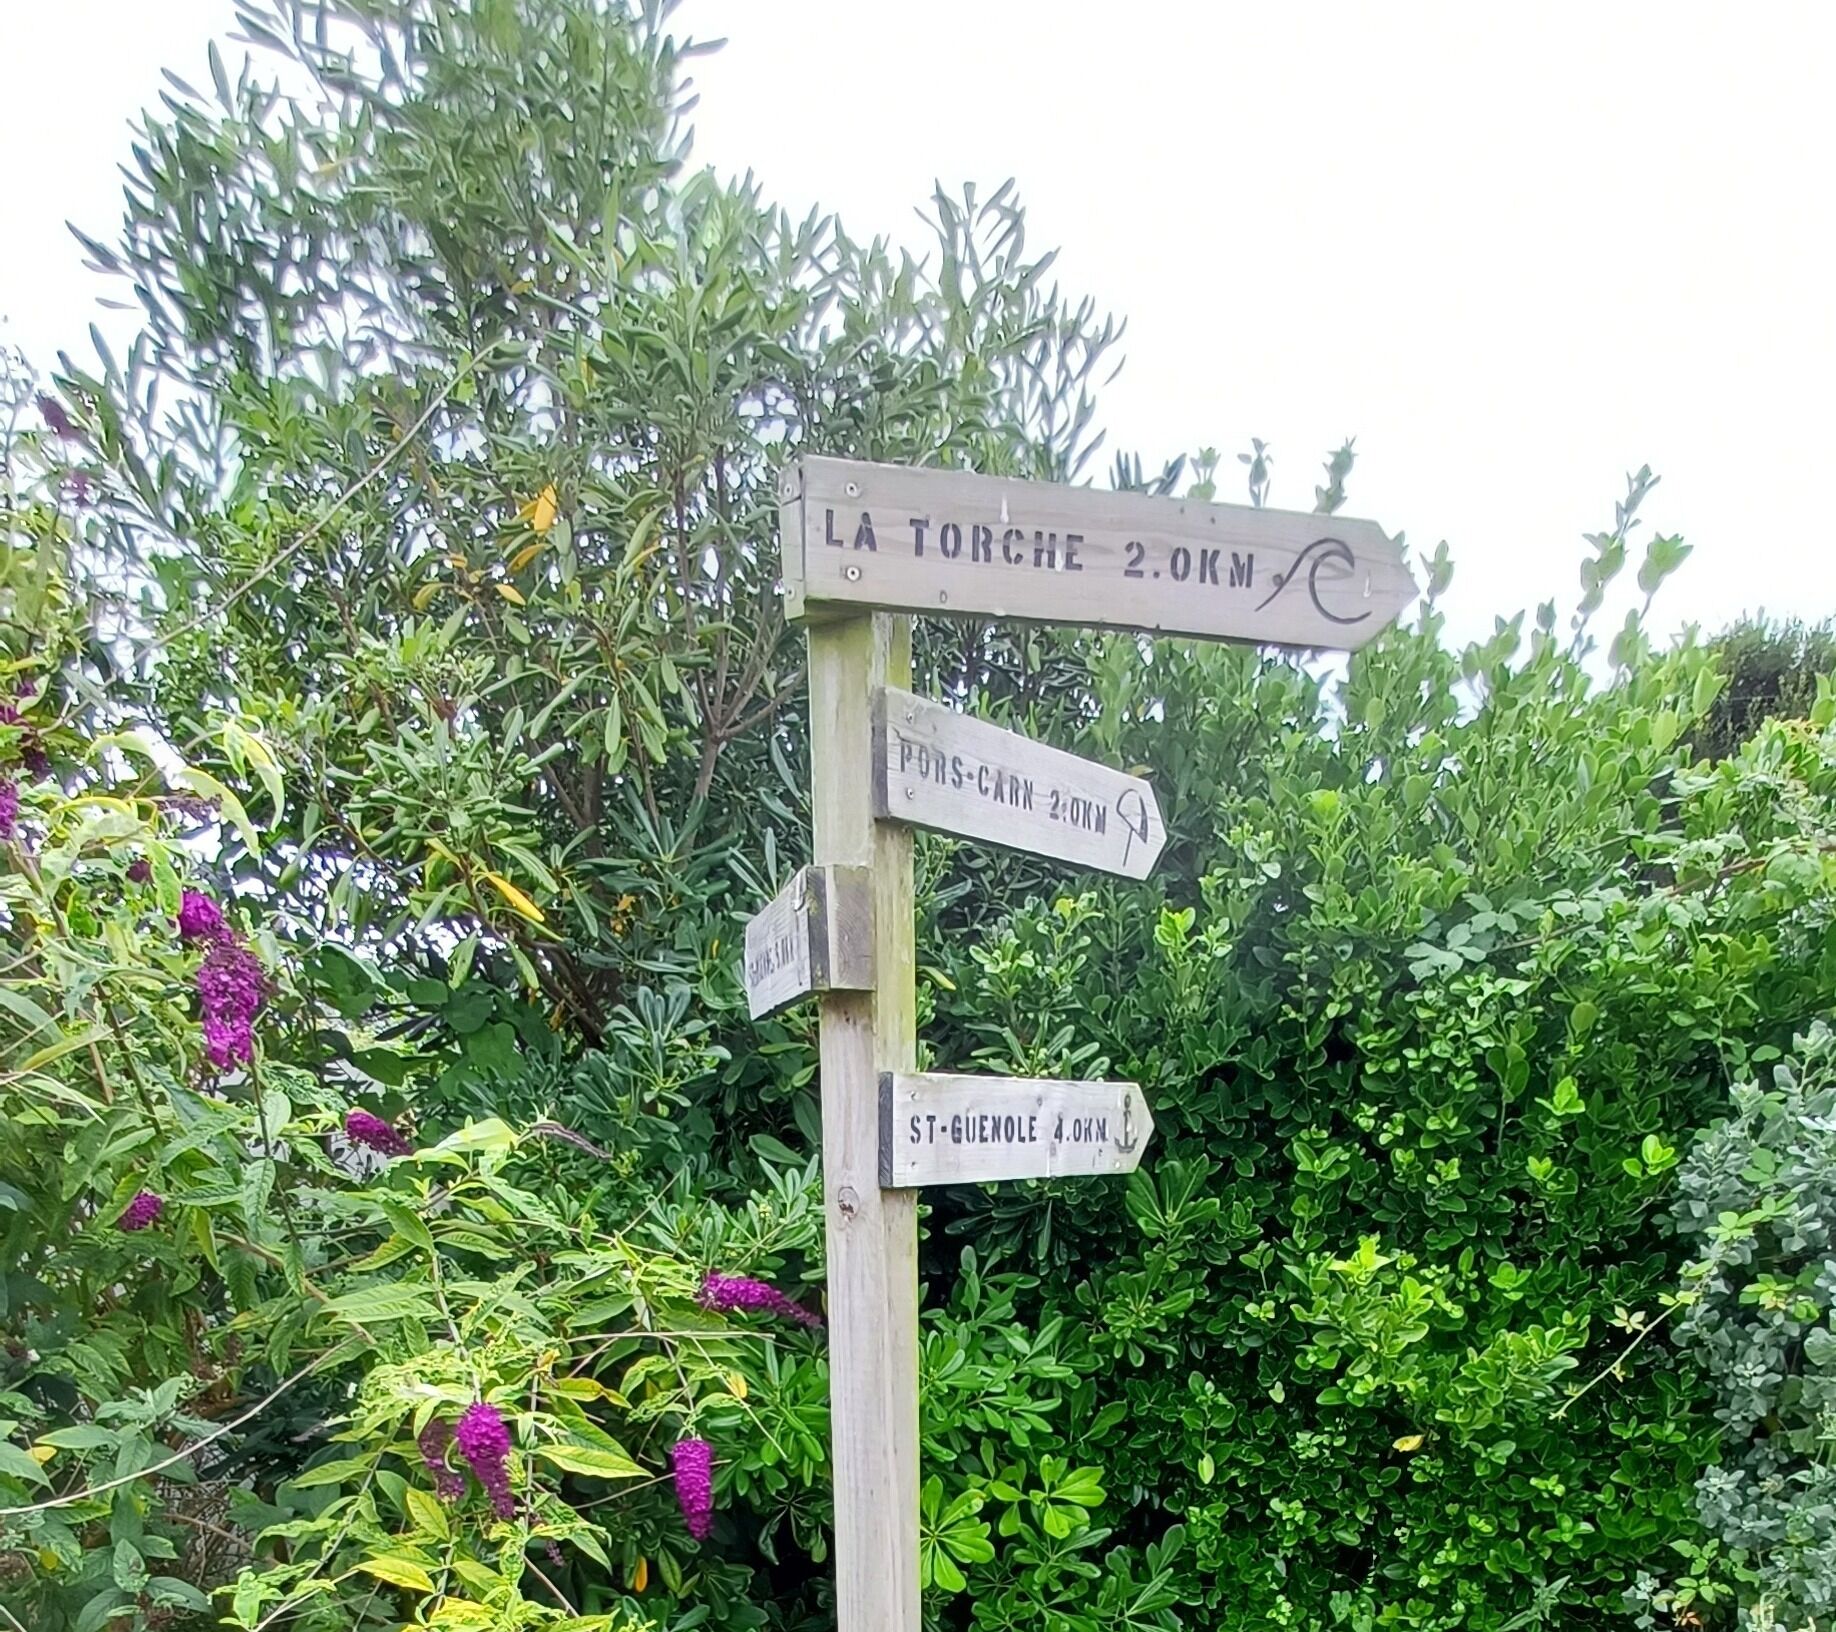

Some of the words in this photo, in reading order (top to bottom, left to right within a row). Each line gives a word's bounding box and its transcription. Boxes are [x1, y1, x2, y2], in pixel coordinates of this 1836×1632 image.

[825, 508, 878, 552] LA
[909, 517, 1085, 572] TORCHE
[1123, 540, 1255, 589] 2.0KM
[909, 1113, 1038, 1145] ST-GUENOLE
